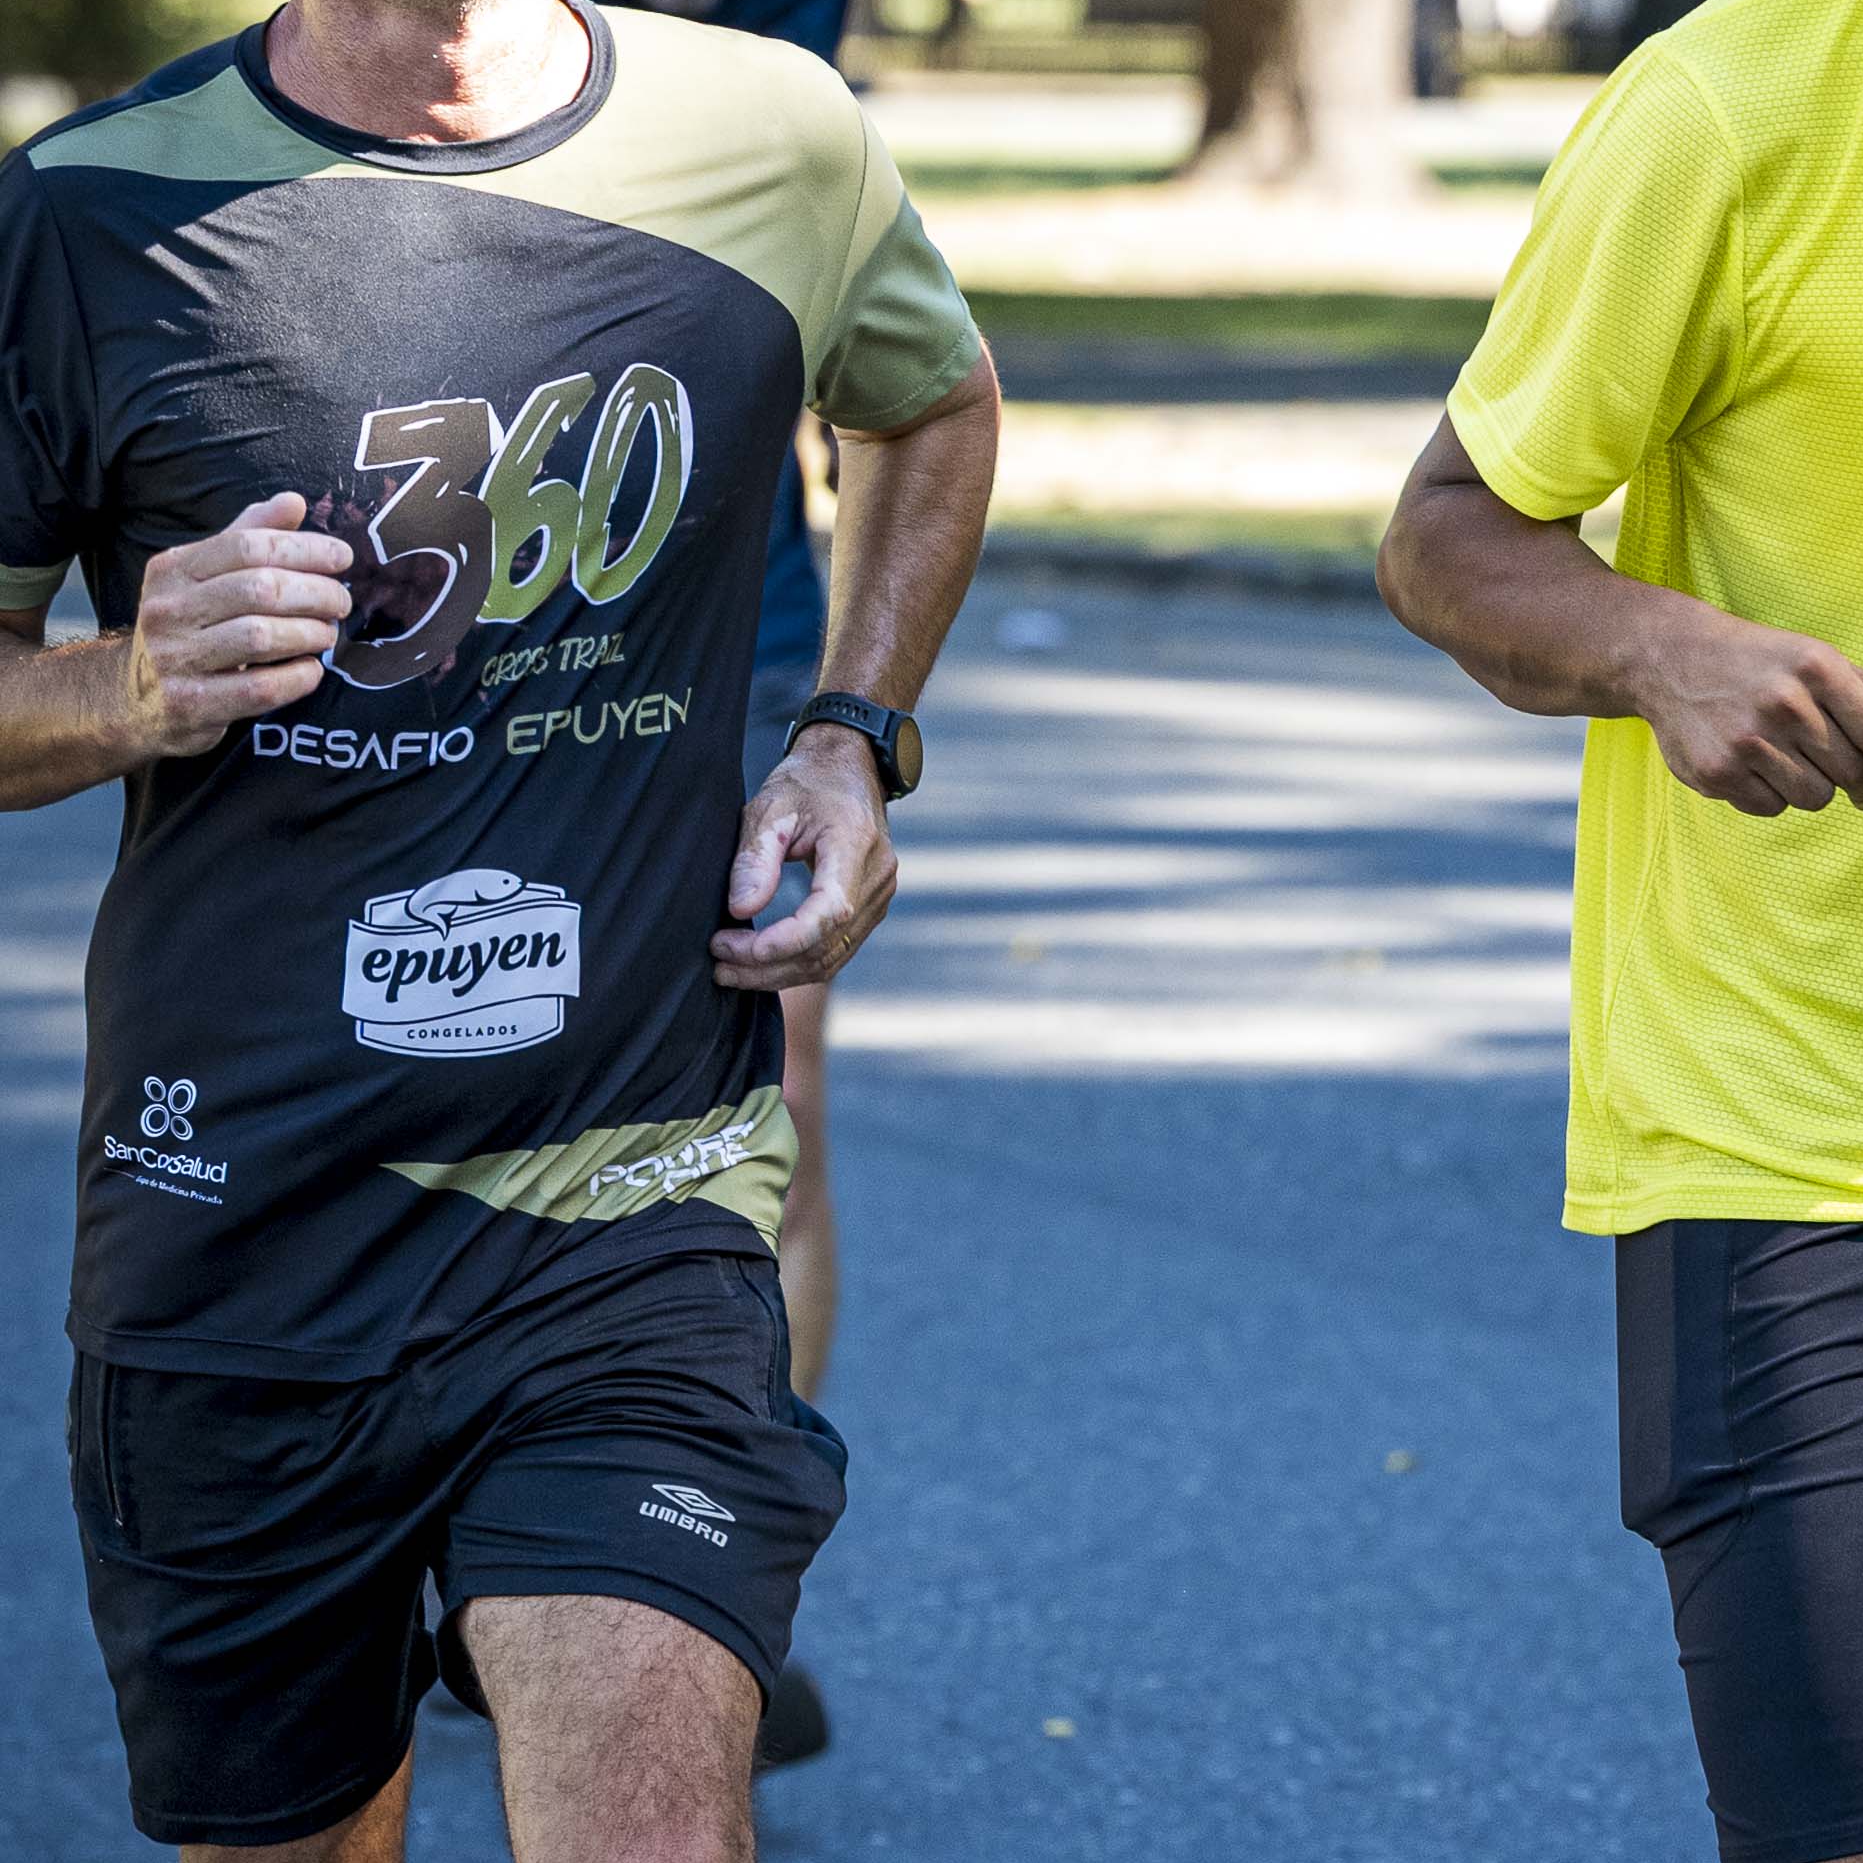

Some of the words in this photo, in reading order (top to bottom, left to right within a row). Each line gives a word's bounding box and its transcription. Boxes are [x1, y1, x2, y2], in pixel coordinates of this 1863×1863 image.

[321, 362, 694, 690] 360
[480, 642, 554, 687] CROS
[253, 723, 474, 770] DESAFIO
[507, 687, 692, 755] EPUYEN
[361, 931, 566, 1003] epuyen
[407, 1025, 518, 1040] CONGELADOS
